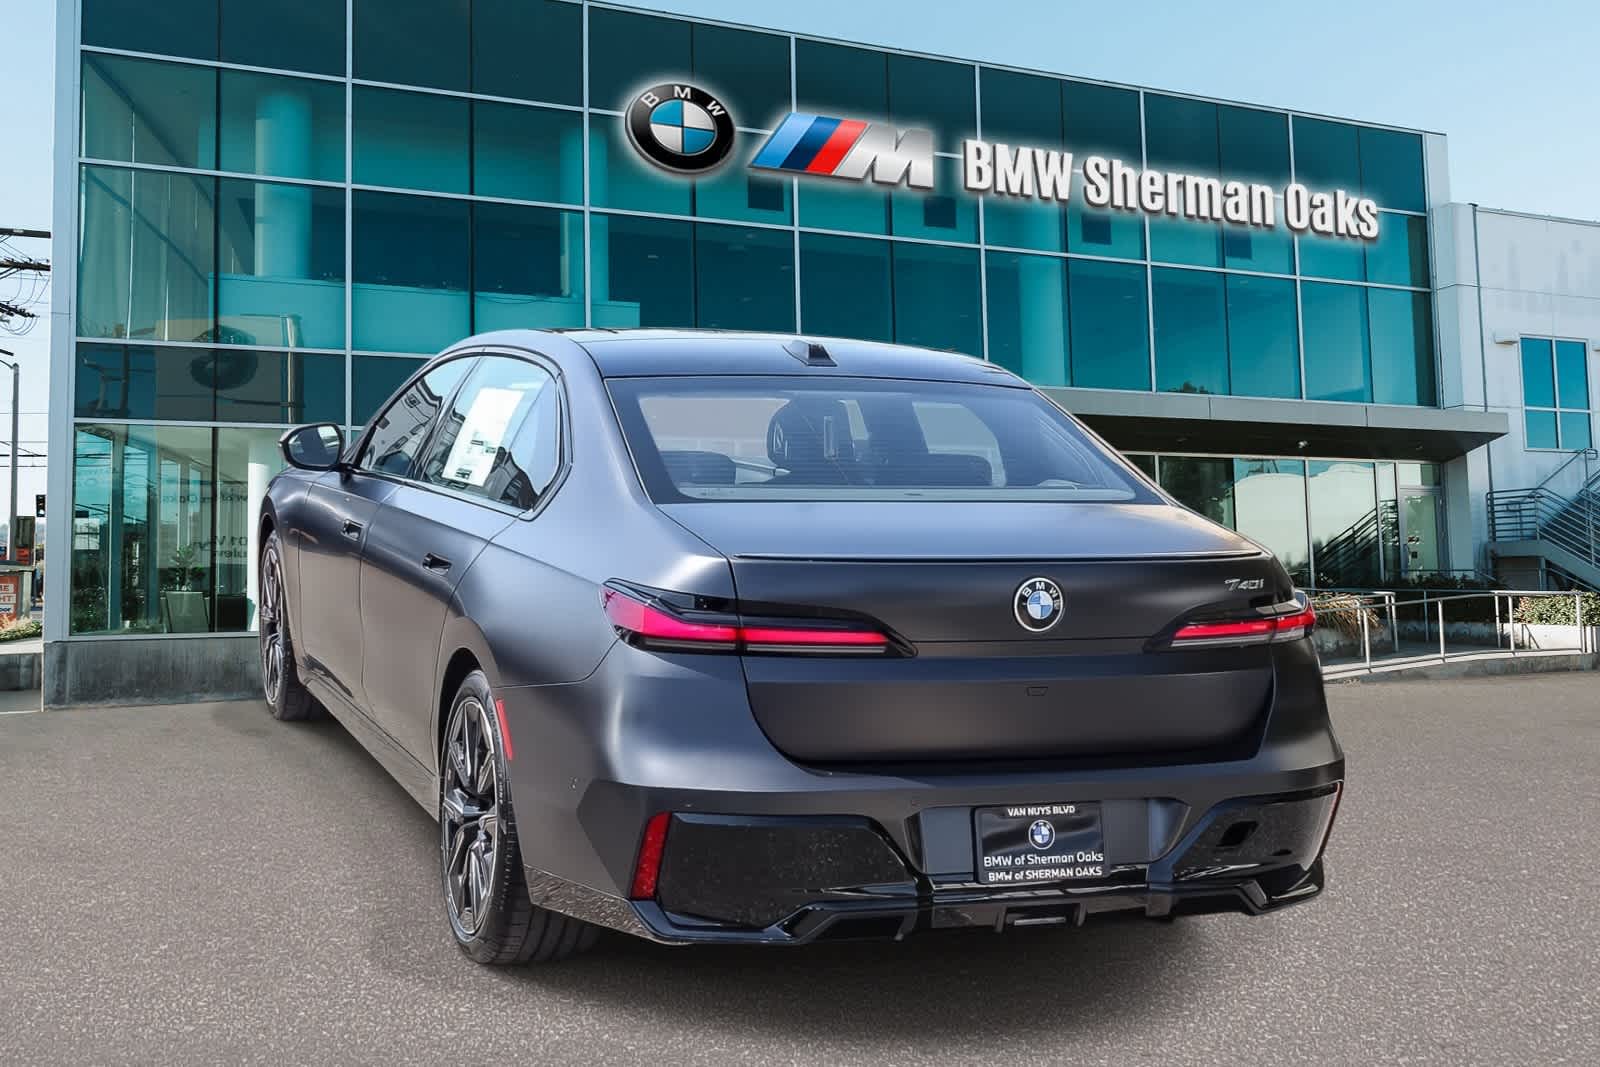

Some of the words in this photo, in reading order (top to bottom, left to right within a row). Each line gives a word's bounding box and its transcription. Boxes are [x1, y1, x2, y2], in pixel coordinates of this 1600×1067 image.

[641, 86, 726, 117] BMW
[963, 139, 1074, 203] BMW
[1083, 155, 1275, 228] Sherman
[1284, 181, 1379, 240] Oaks
[1022, 581, 1059, 598] BMW
[1224, 578, 1265, 592] 740i
[1007, 807, 1026, 817] VAN
[1027, 806, 1052, 816] NUYS
[1052, 805, 1076, 815] BLVD
[983, 856, 1012, 867] BMW
[1014, 855, 1026, 866] of
[1027, 853, 1075, 865] Sherman
[1076, 850, 1104, 862] Oaks
[988, 871, 1013, 882] BMW
[1014, 869, 1025, 880] of
[1025, 868, 1074, 880] SHERMAN
[1075, 866, 1103, 877] OAKS
